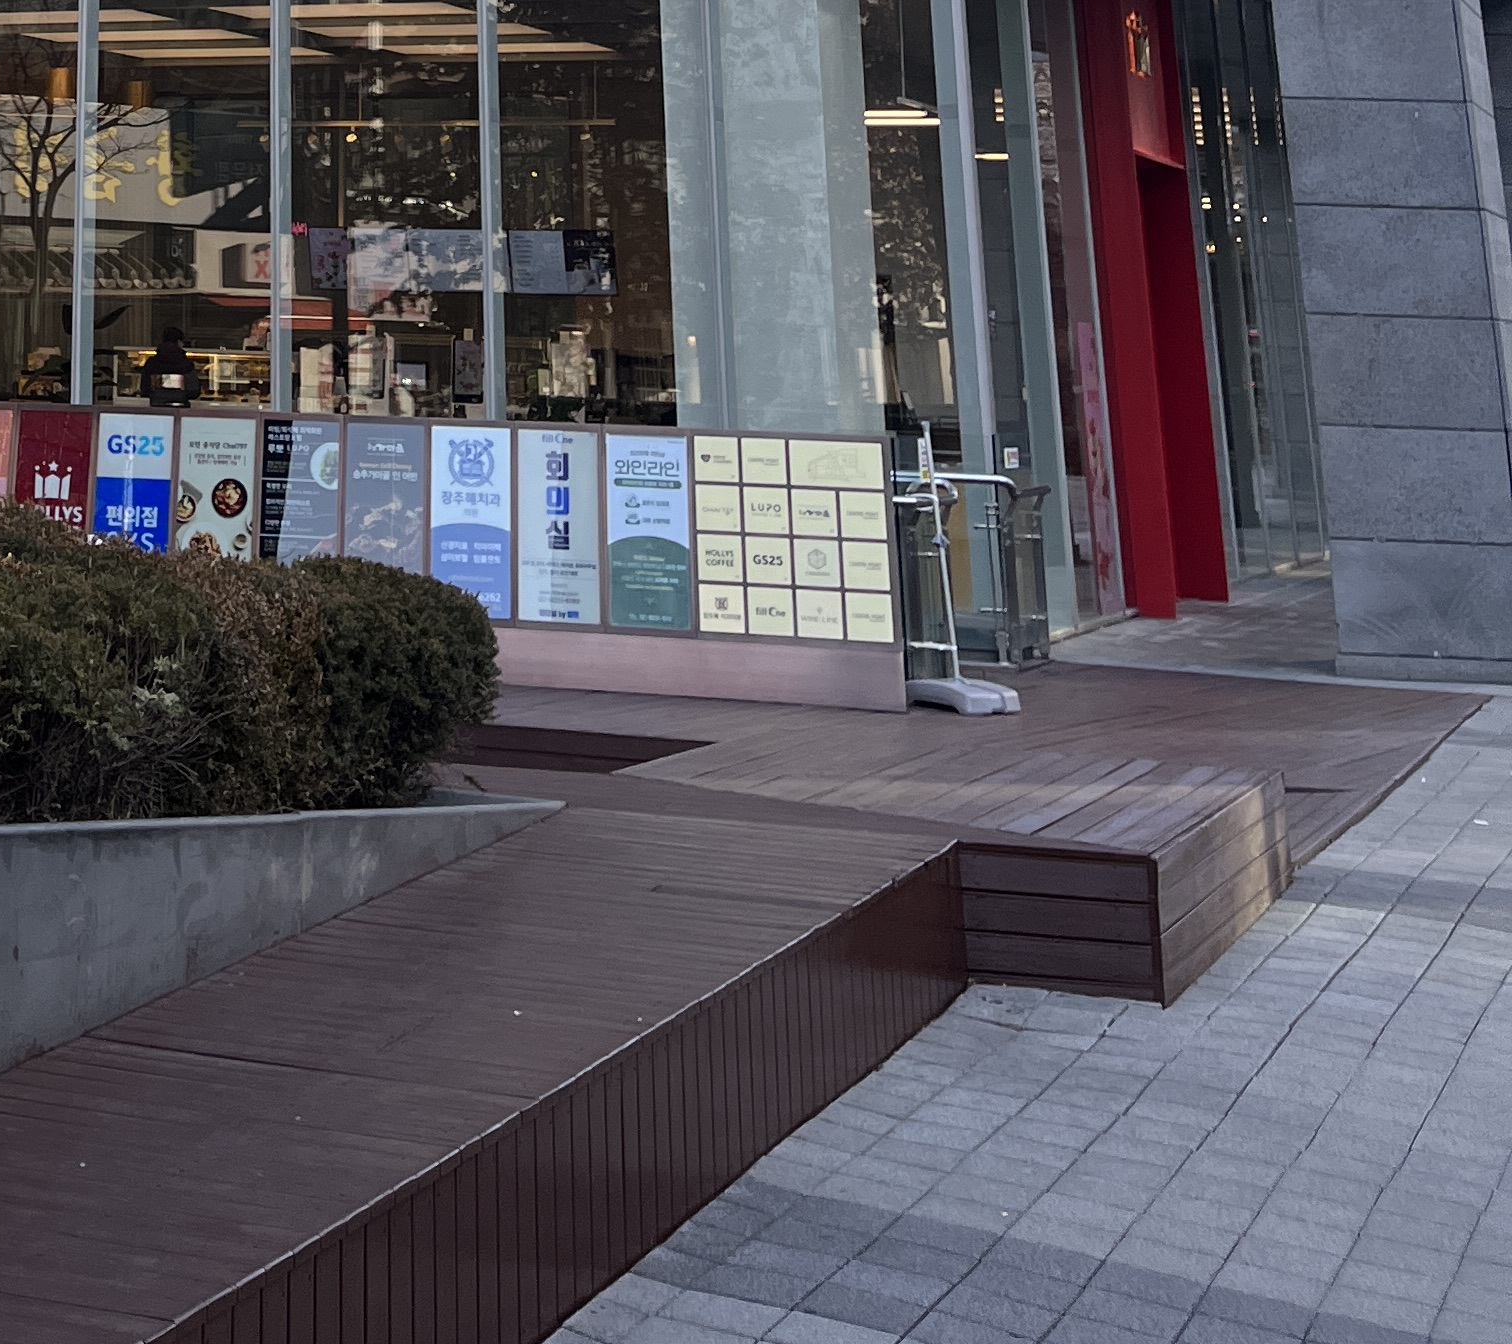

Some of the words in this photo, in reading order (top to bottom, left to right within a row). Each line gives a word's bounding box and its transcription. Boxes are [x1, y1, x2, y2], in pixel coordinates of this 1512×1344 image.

[107, 434, 165, 457] GS25
[614, 459, 680, 478] 와인라인
[441, 490, 501, 507] 장주혜치과
[545, 450, 570, 550] 회의실
[35, 505, 83, 523] LLYS
[750, 502, 782, 513] LUPO
[105, 504, 159, 529] 편의점
[705, 549, 734, 558] HOLLYS
[753, 554, 784, 567] GS25
[706, 558, 735, 567] COFFEE
